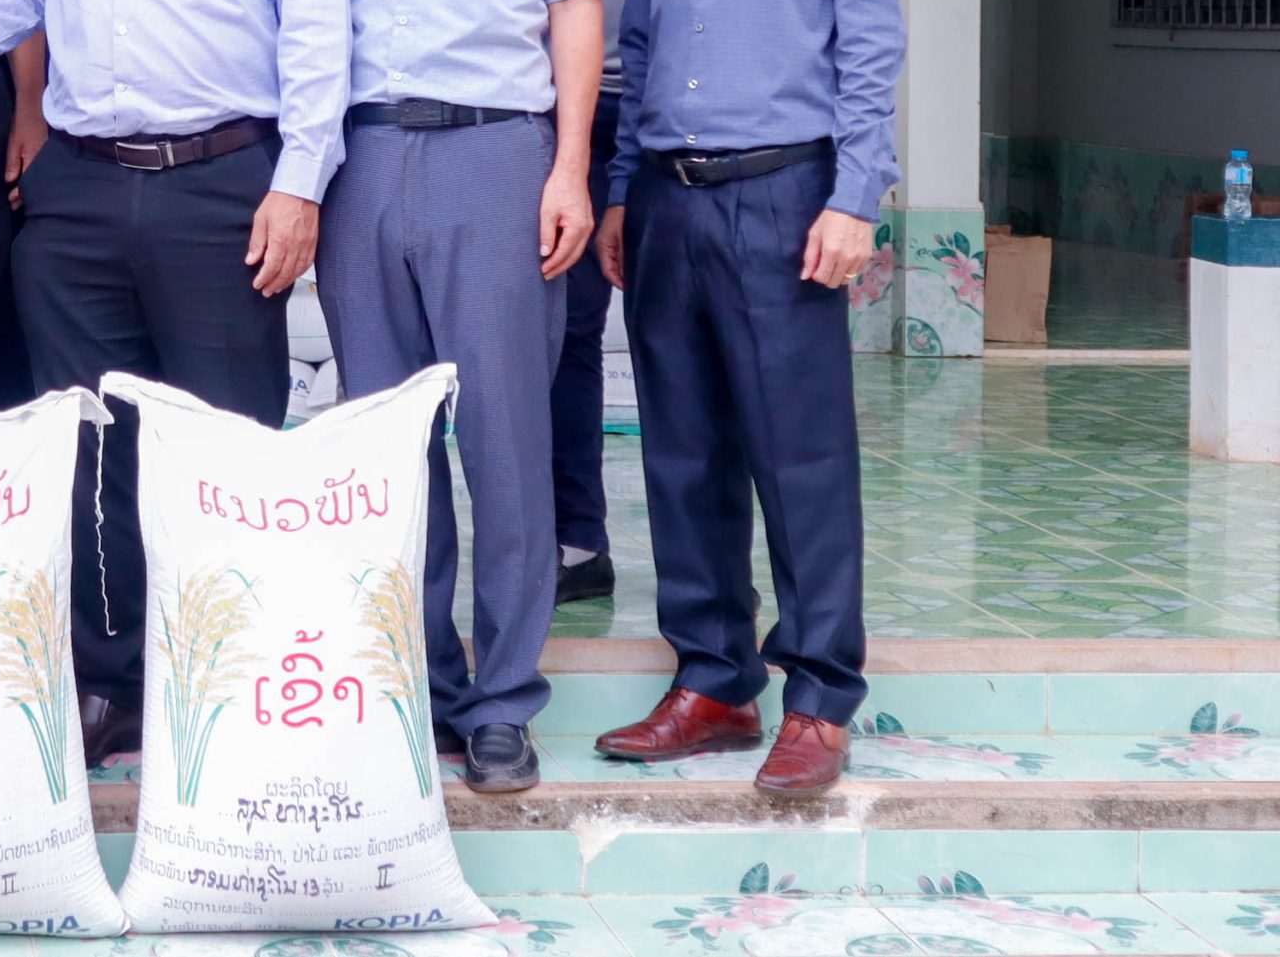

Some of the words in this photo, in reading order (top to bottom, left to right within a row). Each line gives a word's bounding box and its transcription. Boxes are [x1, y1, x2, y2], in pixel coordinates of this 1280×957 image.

[198, 468, 388, 532] ແນວພັນ
[255, 630, 363, 728] ເຂົ້າ
[333, 846, 362, 861] ແລະ
[303, 878, 320, 897] 13
[334, 908, 444, 929] KOPIA
